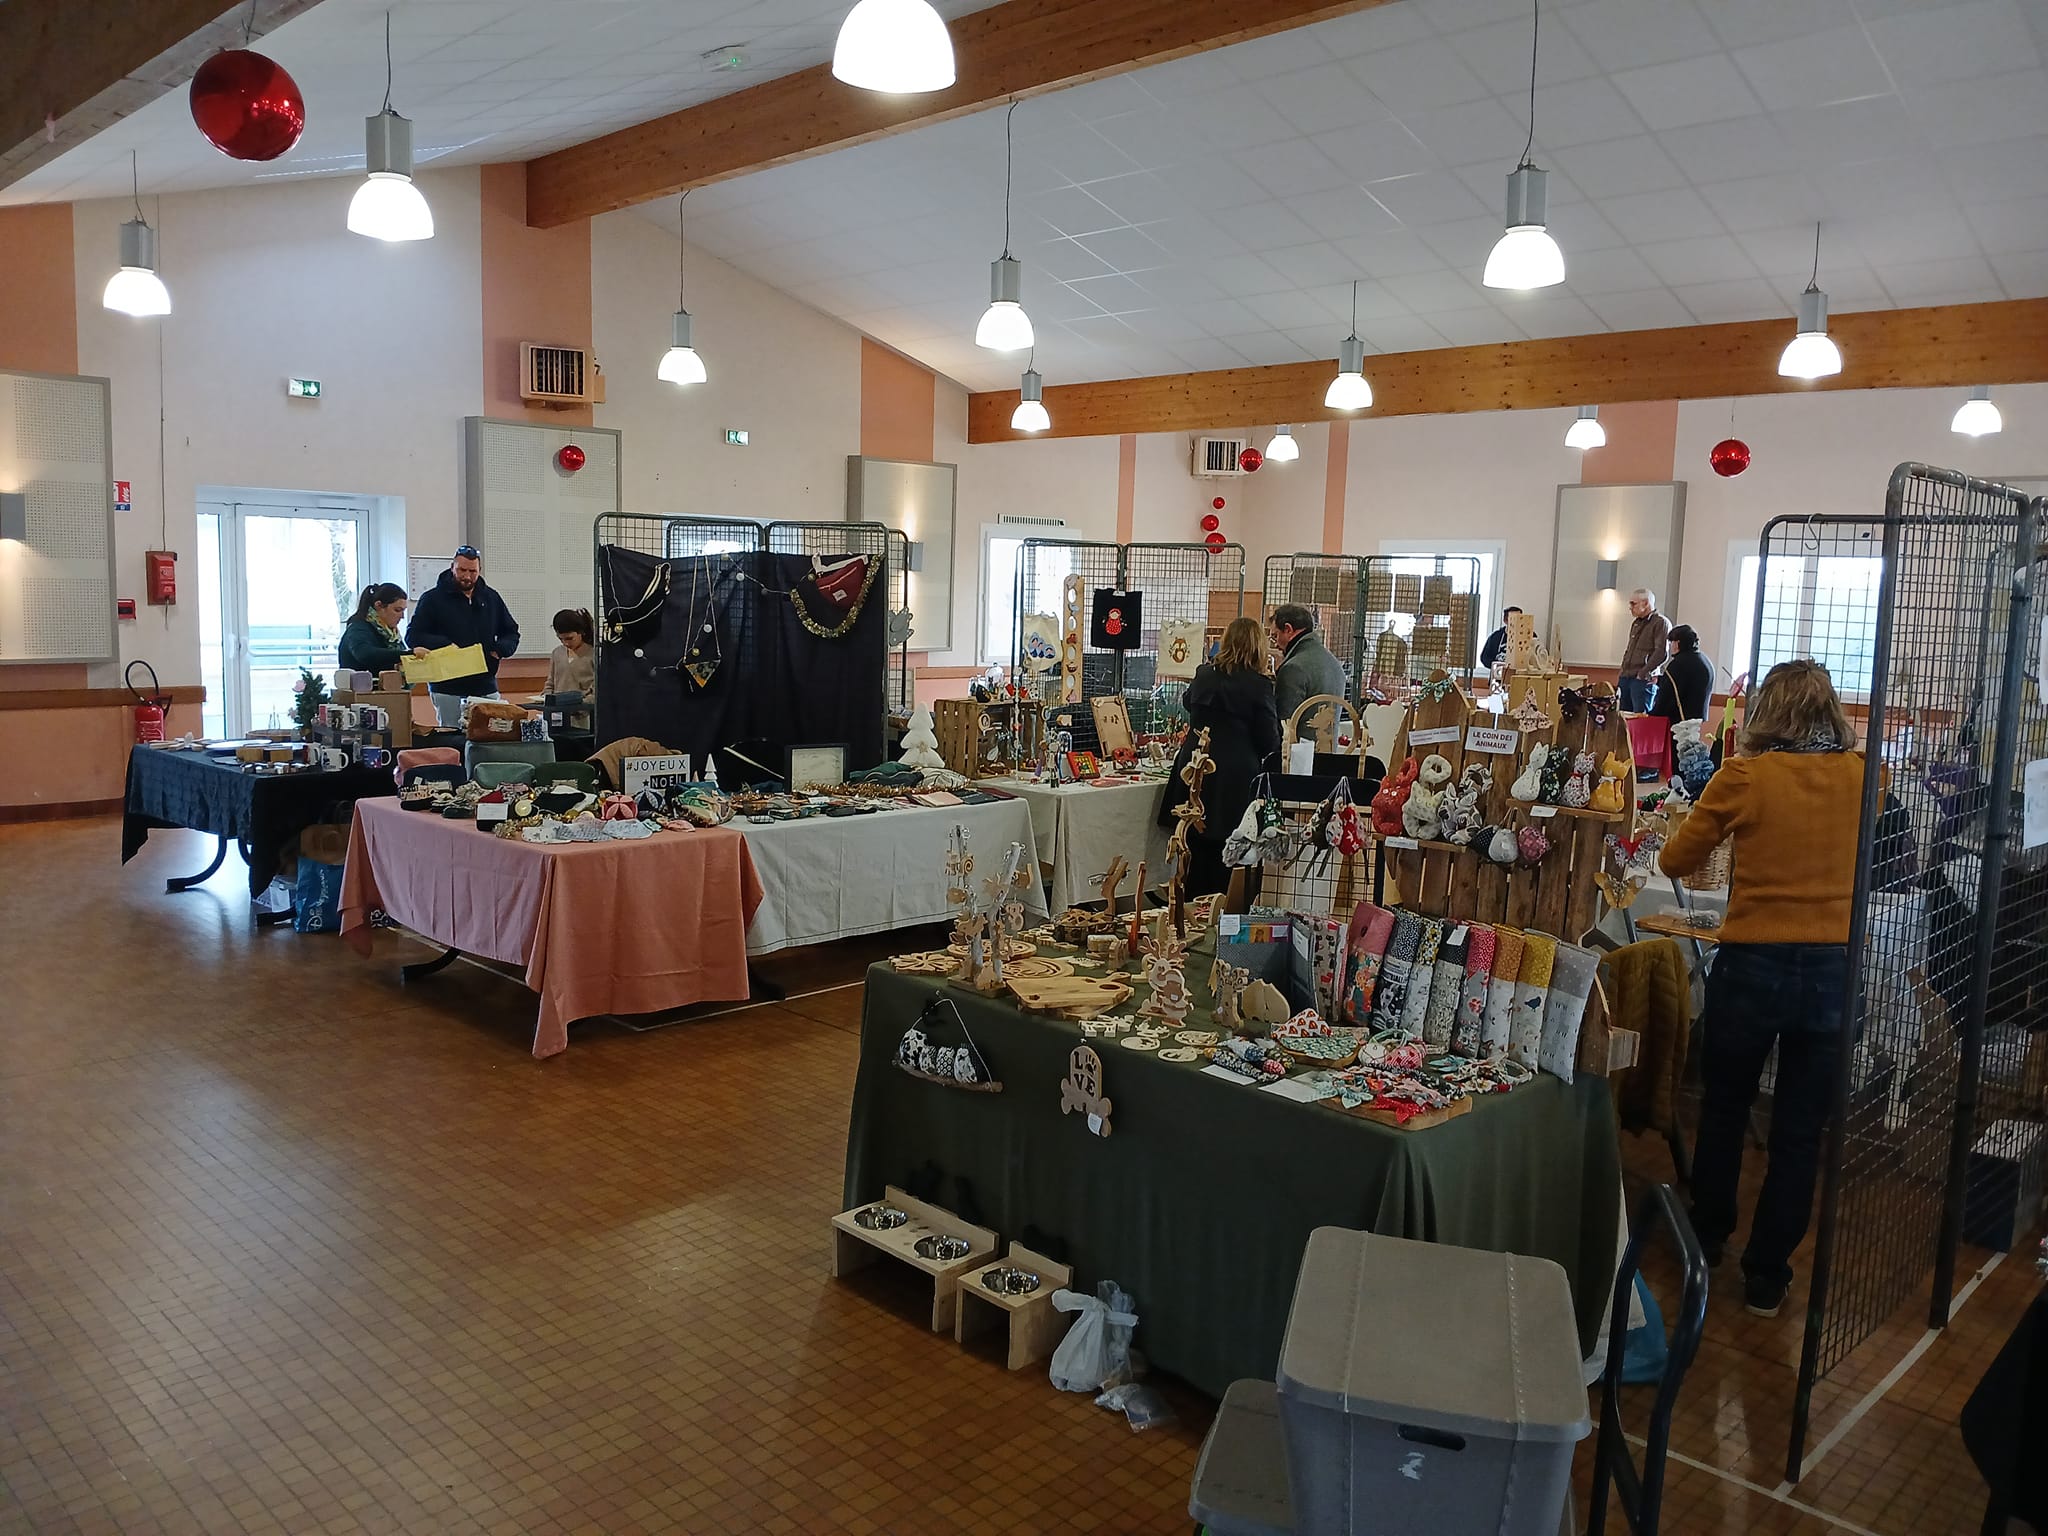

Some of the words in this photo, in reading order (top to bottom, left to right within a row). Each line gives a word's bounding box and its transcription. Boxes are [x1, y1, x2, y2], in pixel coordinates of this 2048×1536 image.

[1482, 732, 1498, 740] COIN
[1475, 740, 1507, 749] ANIMAUX
[626, 759, 685, 771] #JOYEUX
